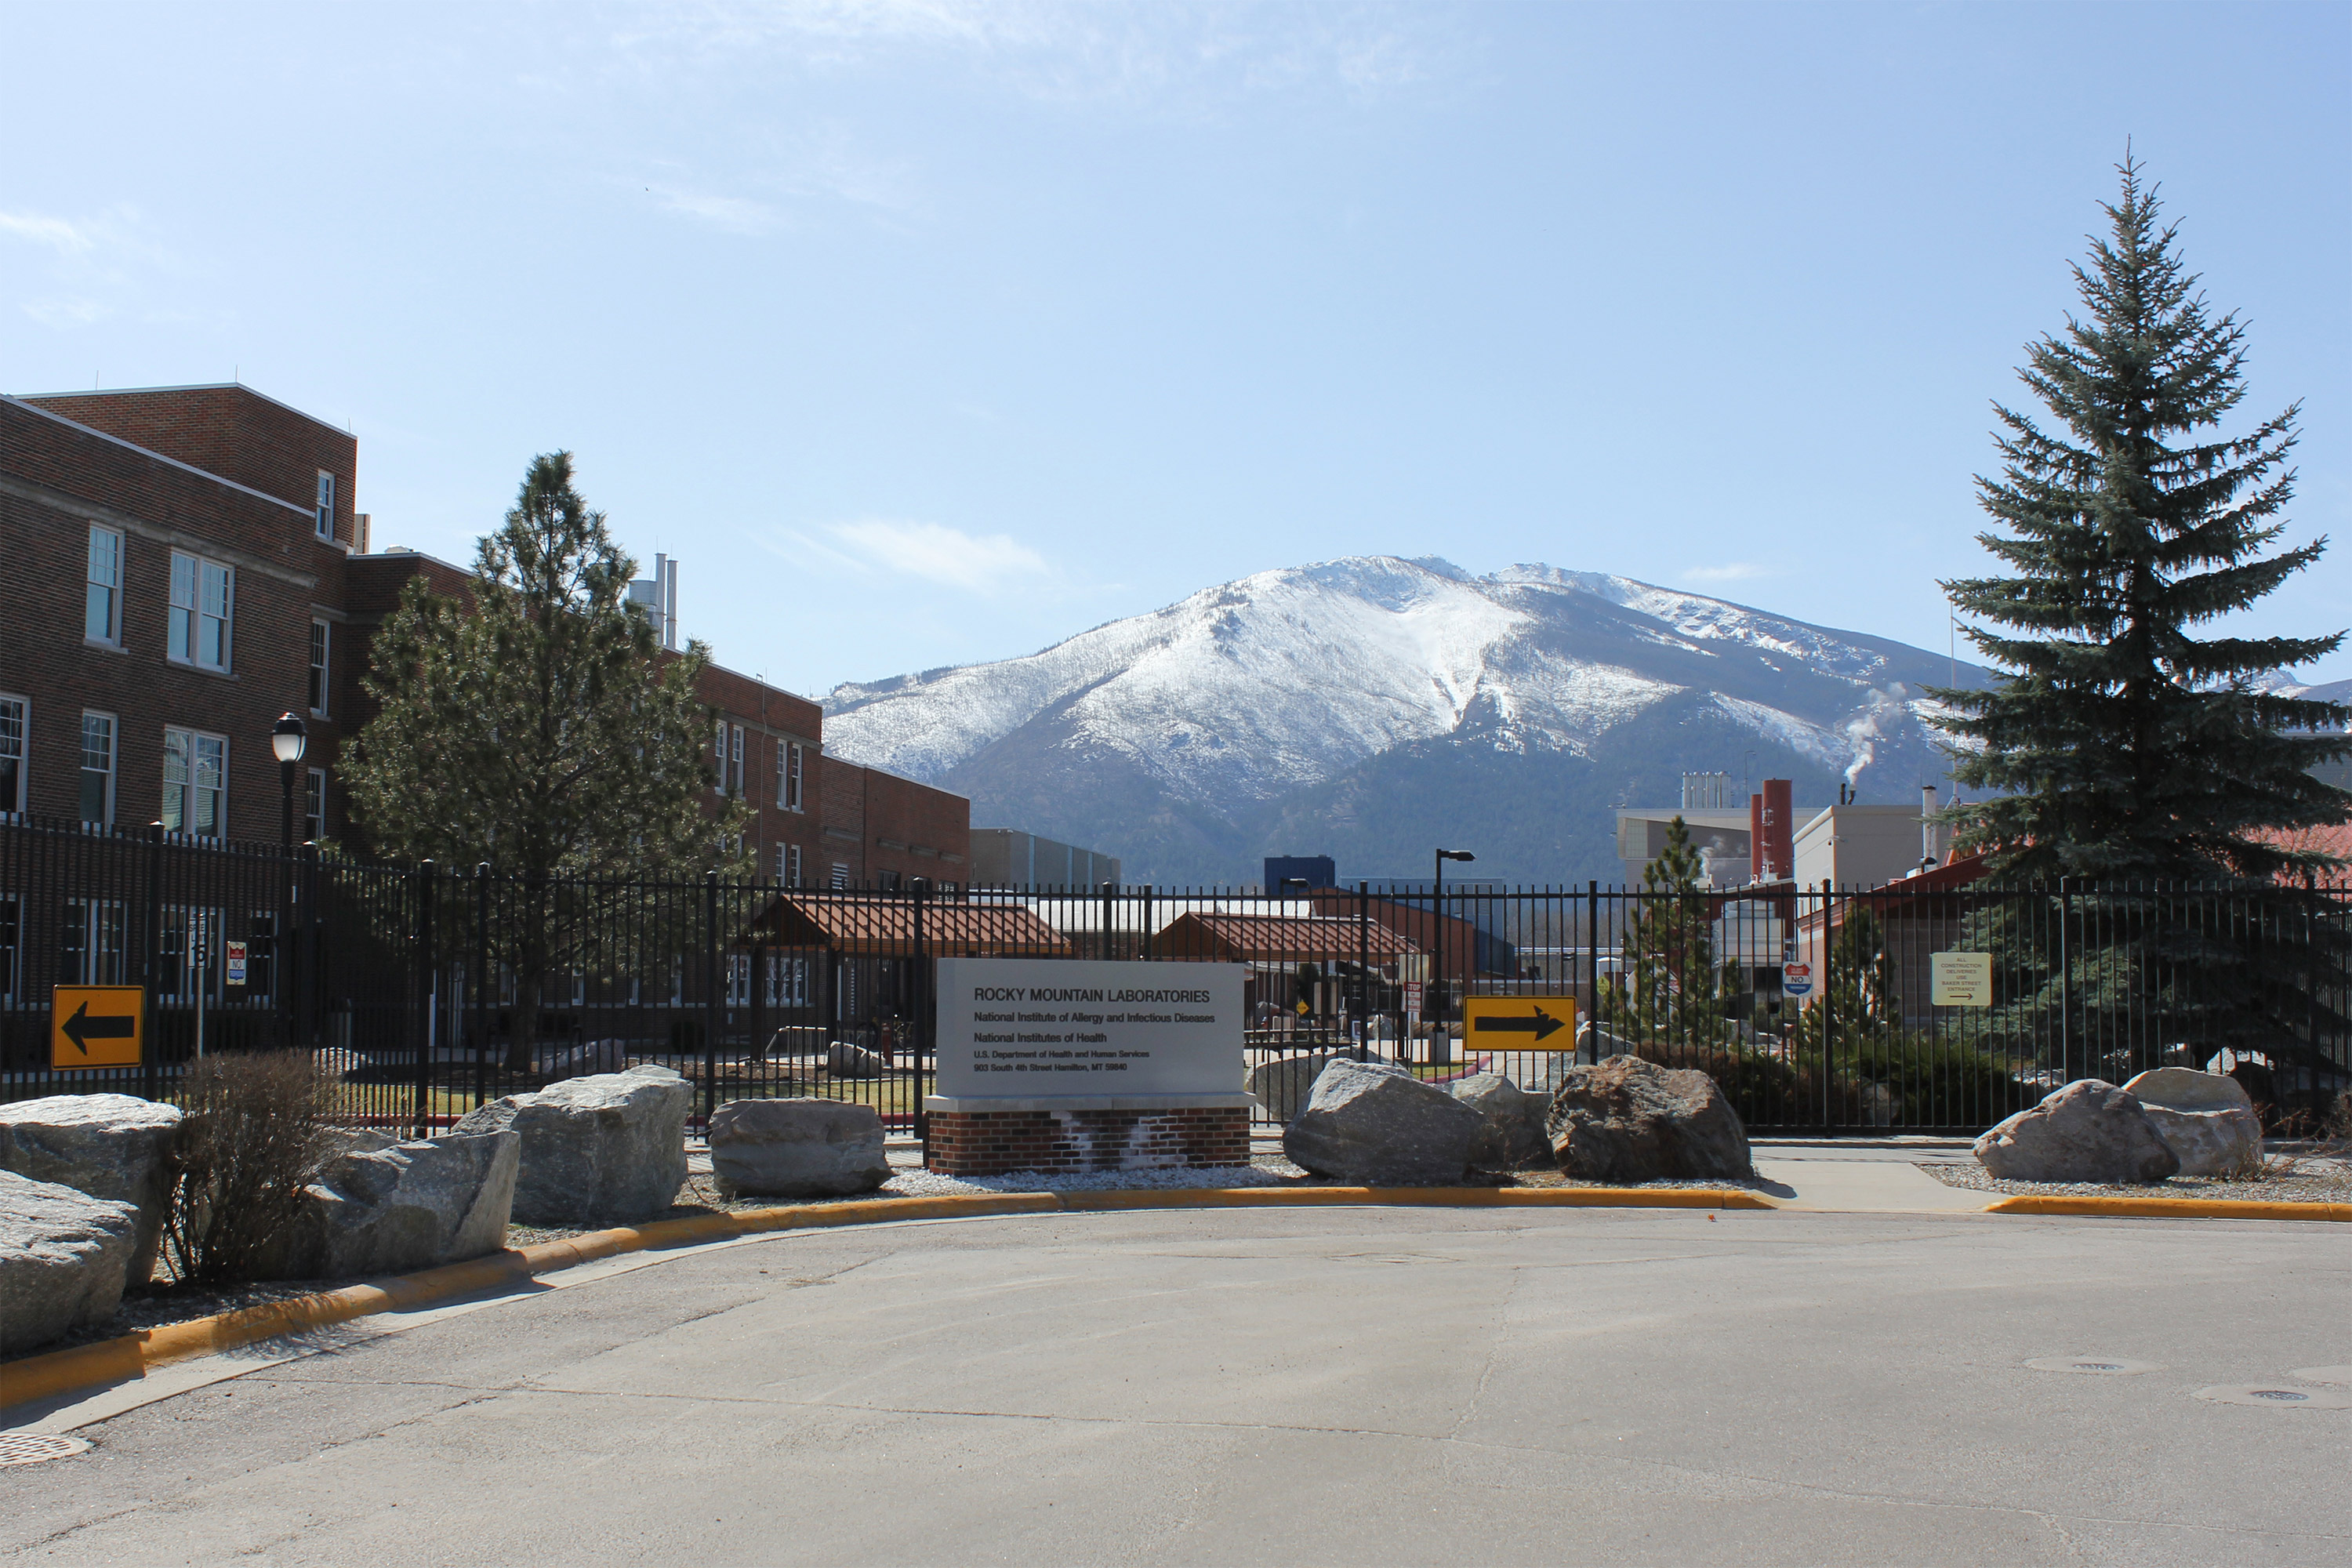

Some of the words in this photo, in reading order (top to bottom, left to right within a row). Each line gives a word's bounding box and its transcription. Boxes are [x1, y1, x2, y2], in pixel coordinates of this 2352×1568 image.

[974, 988, 1025, 1001] ROCKY
[1029, 988, 1103, 1002] MOUNTAIN
[1108, 989, 1210, 1003] LABORATORIES
[974, 1011, 1014, 1022] National
[1018, 1011, 1056, 1022] Institute
[1059, 1012, 1069, 1022] of
[1071, 1012, 1104, 1025] Allergy
[1106, 1013, 1124, 1022] and
[1127, 1012, 1171, 1022] Infectious
[1174, 1013, 1214, 1022] Diseases
[974, 1033, 1014, 1043] National
[1018, 1033, 1062, 1043] Institutes
[1064, 1033, 1074, 1043] of
[1076, 1033, 1107, 1043] Health
[992, 1051, 1037, 1060] Department
